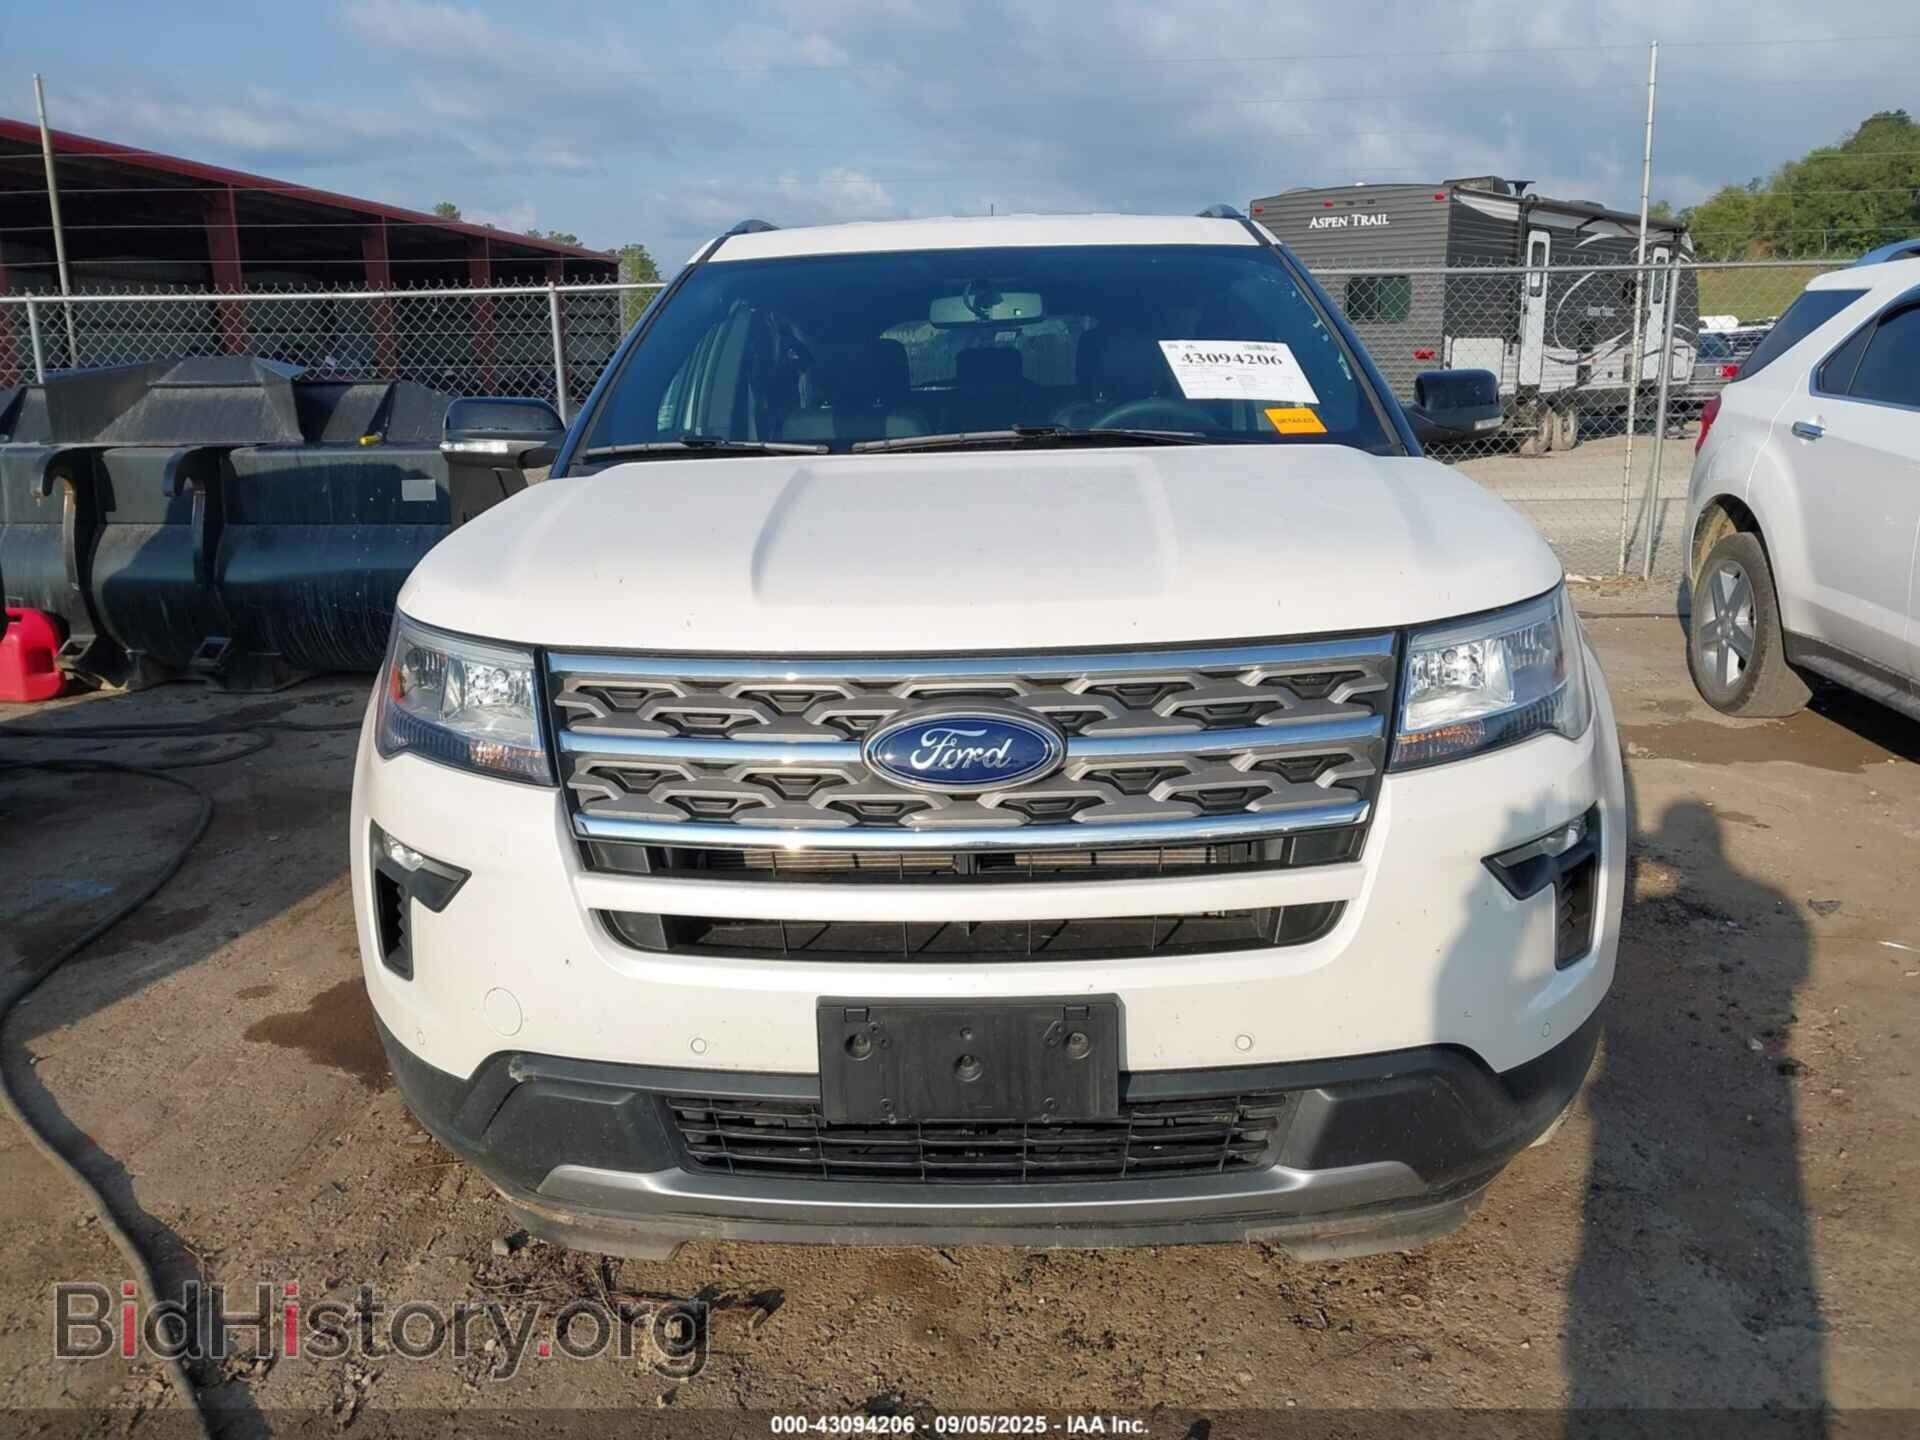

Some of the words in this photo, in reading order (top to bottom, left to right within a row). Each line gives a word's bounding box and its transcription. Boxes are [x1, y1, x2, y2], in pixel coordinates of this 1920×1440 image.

[1308, 216, 1348, 229] ASPEN
[1351, 214, 1389, 226] TRAIL
[1181, 352, 1283, 366] 43094206
[909, 727, 1014, 770] Ford
